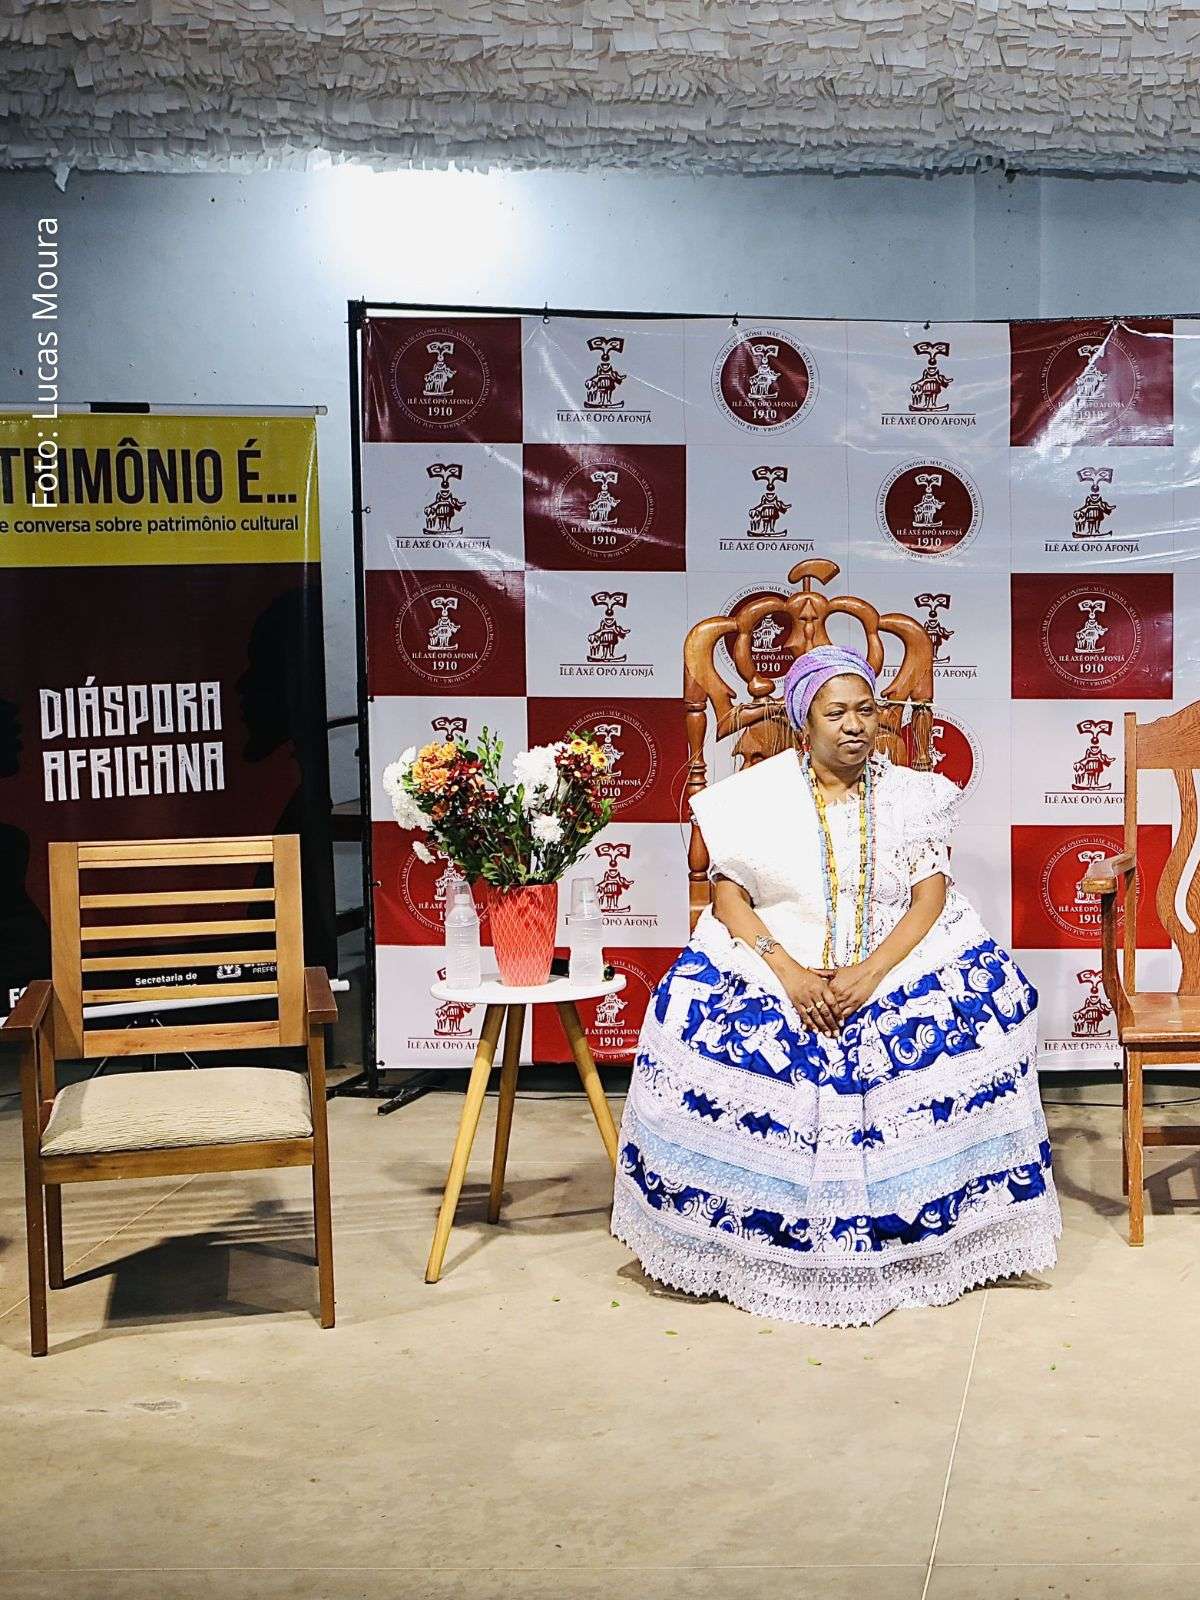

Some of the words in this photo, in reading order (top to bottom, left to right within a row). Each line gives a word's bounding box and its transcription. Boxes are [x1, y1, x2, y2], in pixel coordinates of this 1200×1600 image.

[428, 407, 453, 416] 1910
[753, 409, 777, 419] 1910
[556, 413, 572, 422] ILÊ
[573, 413, 592, 422] AXÉ
[594, 413, 615, 423] OPÔ
[616, 413, 652, 424] AFONJÁ
[881, 416, 896, 425] ILÊ
[898, 416, 917, 425] AXÉ
[918, 416, 940, 426] OPÔ
[941, 416, 977, 427] AFONJÁ
[0, 437, 223, 504] TRIMÔNIO
[238, 439, 297, 504] É...
[14, 519, 91, 533] conversa
[95, 516, 142, 533] sobre
[147, 516, 236, 535] patrimônio
[241, 515, 299, 532] cultural
[395, 540, 411, 548] ILÊ
[413, 539, 431, 548] AXÉ
[433, 539, 454, 549] OPÔ
[592, 535, 616, 545] 1910
[917, 538, 942, 547] 1910
[719, 542, 734, 550] ILÊ
[736, 542, 755, 550] AXÉ
[756, 542, 778, 551] OPÔ
[779, 542, 815, 552] AFONJÁ
[1044, 543, 1060, 552] ILÊ
[1062, 543, 1080, 552] AXÉ
[1082, 543, 1103, 552] OPÔ
[1104, 543, 1140, 554] AFONJÁ
[433, 661, 457, 670] 1910
[756, 662, 780, 672] 1910
[1080, 664, 1104, 673] 1910
[559, 667, 574, 676] ILÊ
[576, 667, 595, 676] AXÉ
[596, 667, 618, 676] OPÔ
[619, 667, 655, 678] AFONJÁ
[942, 668, 978, 679] AFONJÁ
[40, 676, 223, 740] DIÁSPORA
[42, 741, 225, 801] AFRICANA
[1044, 795, 1059, 804] ILÊ
[1061, 795, 1080, 804] AXÉ
[1081, 795, 1102, 804] OPÔ
[1104, 795, 1124, 804] AFO
[601, 917, 622, 927] OPÔ
[623, 917, 659, 928] AFONJÁ
[136, 974, 183, 986] Secretaria
[186, 972, 198, 981] de
[406, 1041, 422, 1049] ILÊ
[423, 1040, 442, 1049] AXÉ
[444, 1040, 465, 1050] OPÔ
[599, 1037, 624, 1046] 1910
[1044, 1042, 1059, 1051] ILÊ
[1061, 1042, 1080, 1051] AXÉ
[1081, 1042, 1102, 1051] OPÔ
